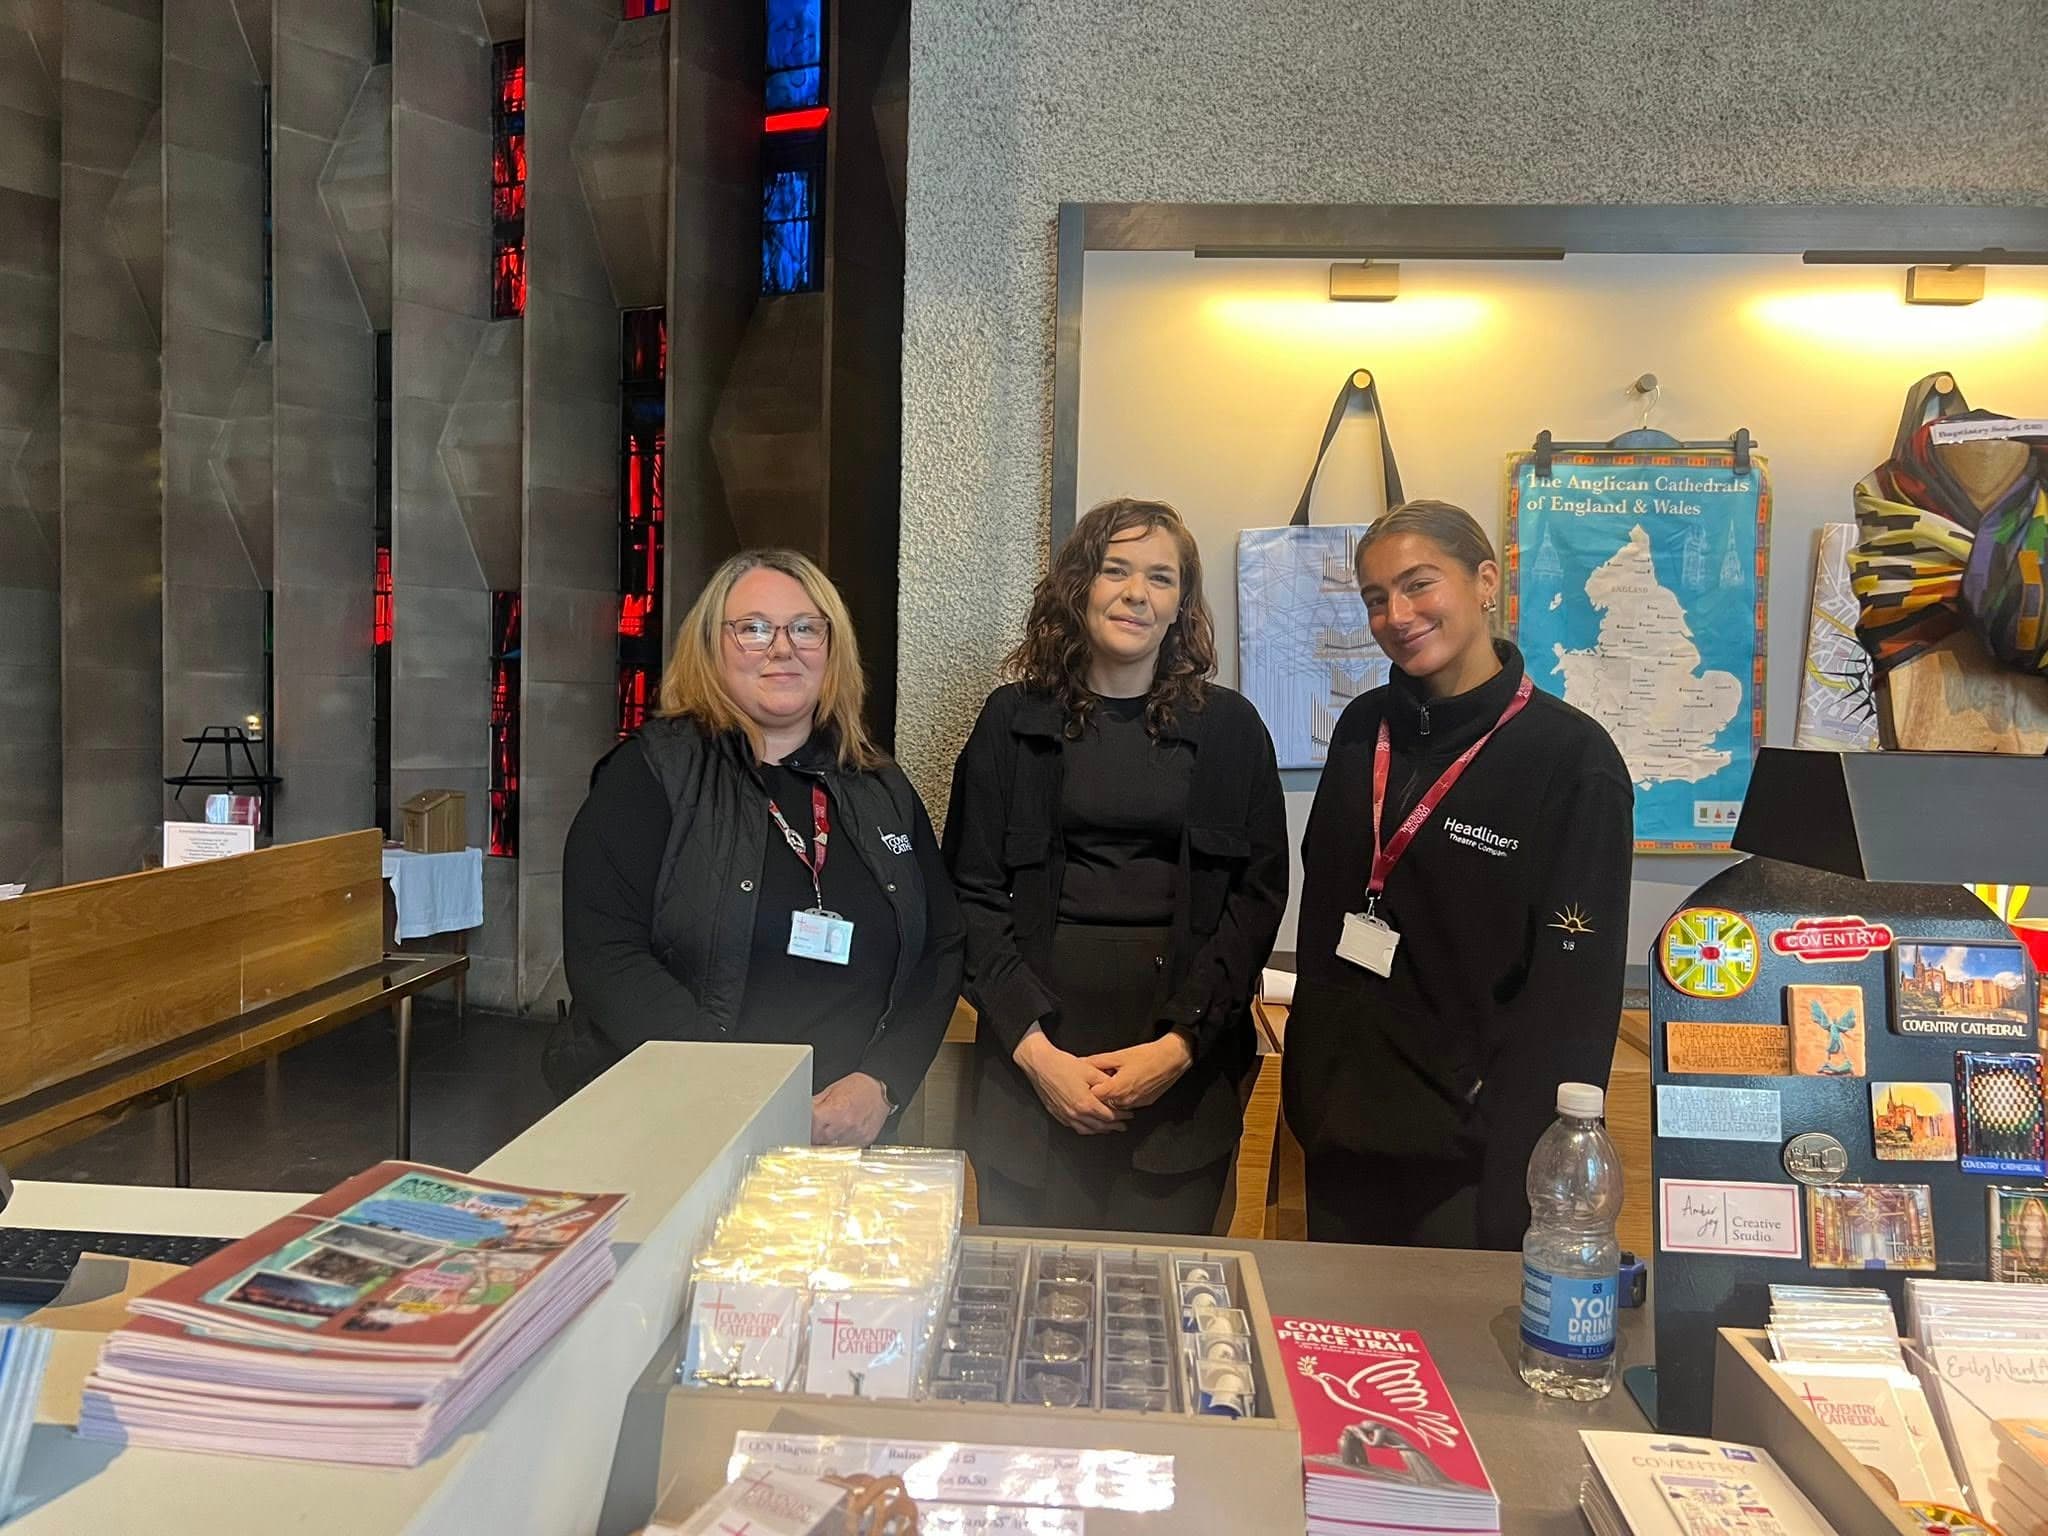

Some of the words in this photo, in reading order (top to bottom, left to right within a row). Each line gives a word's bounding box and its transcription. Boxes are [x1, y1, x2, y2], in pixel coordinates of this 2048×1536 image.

[1526, 472, 1562, 488] The
[1568, 474, 1649, 494] Anglican
[1655, 476, 1750, 493] Cathedrals
[1527, 496, 1545, 511] of
[1551, 496, 1627, 517] England
[1633, 499, 1648, 514] &
[1653, 499, 1701, 515] Wales
[1443, 817, 1519, 850] Headliners
[1449, 833, 1477, 848] Theatre
[1478, 843, 1508, 857] Compan
[1786, 932, 1878, 947] COVENTRY
[1902, 1020, 1958, 1034] COVENTRY
[1960, 1022, 2027, 1037] CATHEDRAL
[1961, 1160, 1999, 1169] COVENTRY
[1682, 1195, 1718, 1217] Amber
[1732, 1216, 1781, 1230] Creative
[1732, 1230, 1772, 1242] Studio
[1570, 1294, 1614, 1318] YOU
[720, 1312, 780, 1326] COVENTRY
[1569, 1318, 1612, 1335] DRINK
[839, 1327, 898, 1342] COVENTRY
[1284, 1320, 1401, 1341] COVENTRY
[1278, 1329, 1349, 1347] PEACE
[1352, 1338, 1420, 1352] TRAIL
[1817, 1403, 1876, 1415] COVENTRY
[1820, 1414, 1889, 1427] CATHEDRAL
[1632, 1456, 1750, 1474] COVENTRY
